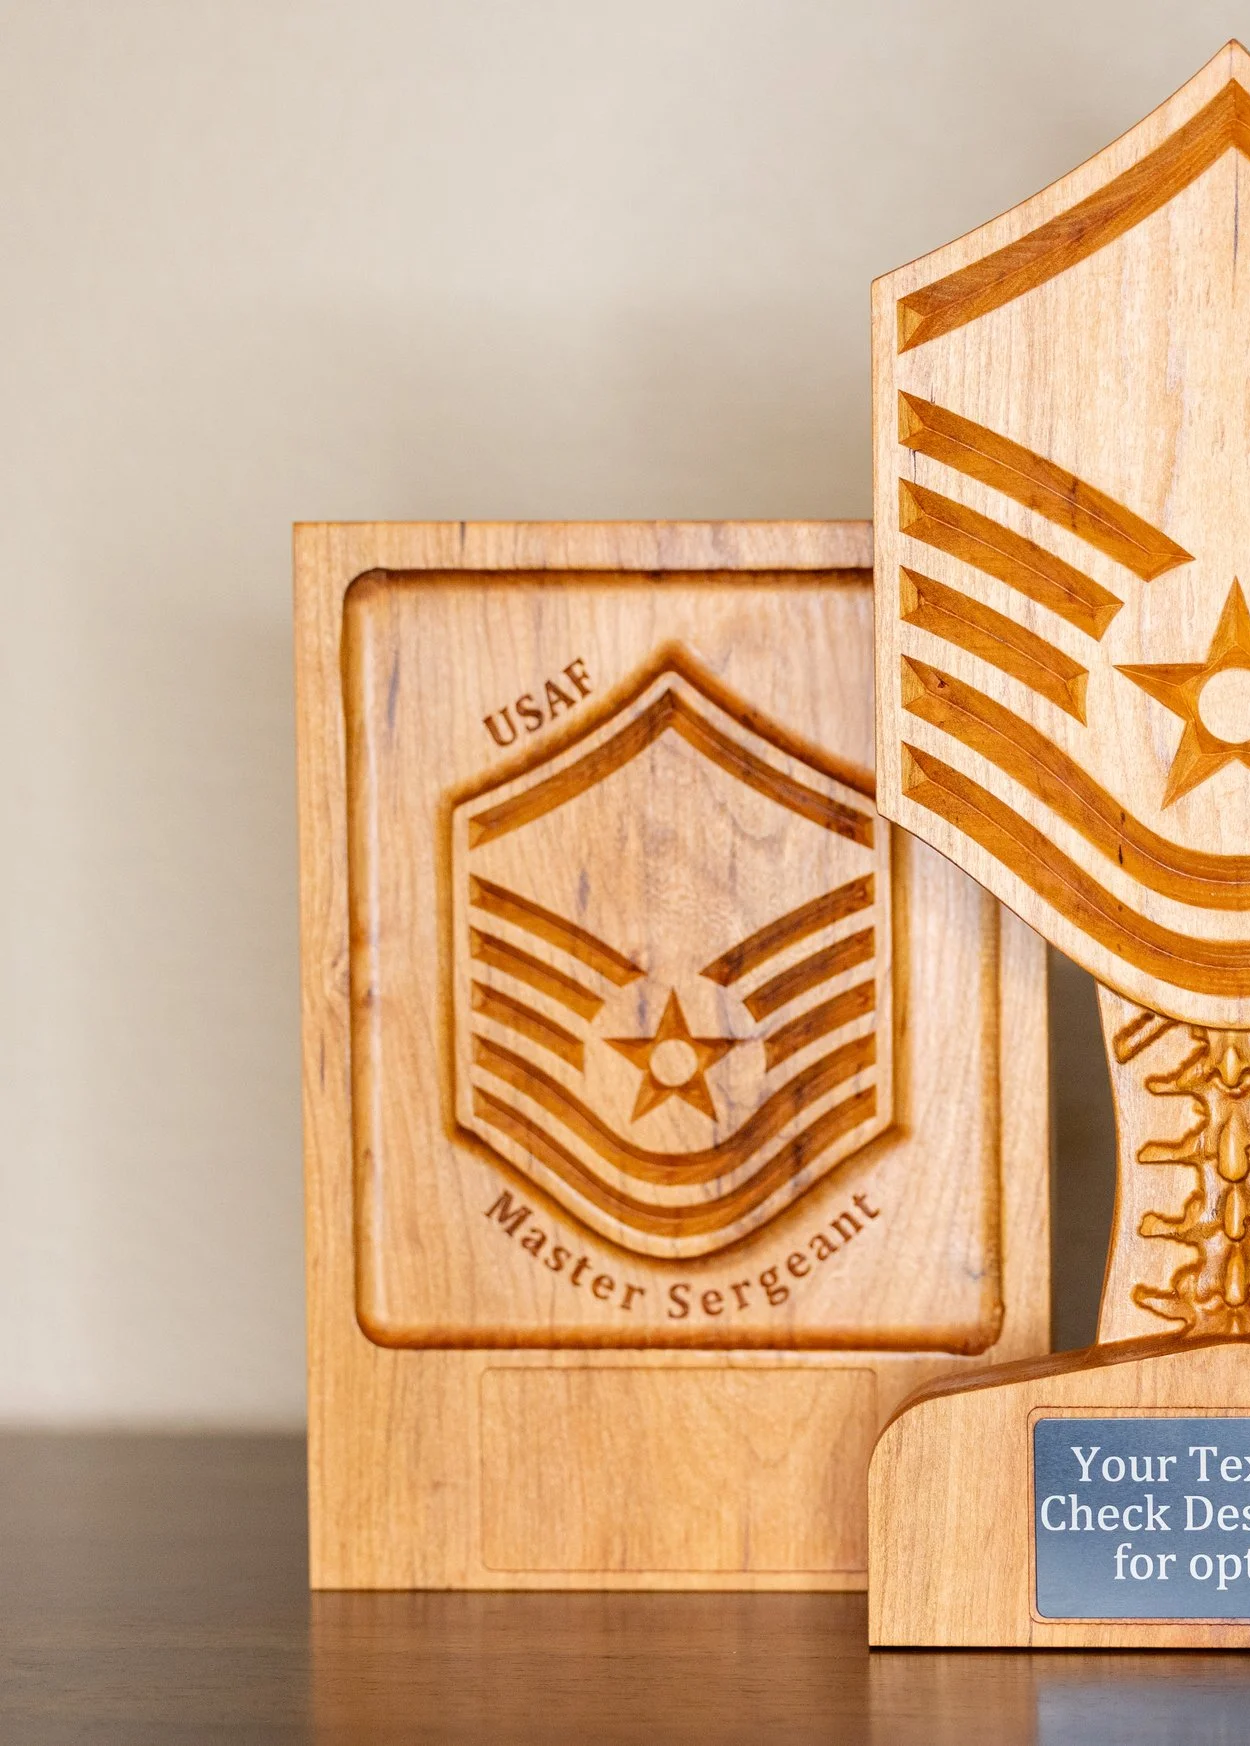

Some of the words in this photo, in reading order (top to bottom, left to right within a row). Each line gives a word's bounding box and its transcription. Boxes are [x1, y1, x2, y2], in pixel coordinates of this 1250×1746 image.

[482, 658, 592, 746] USAF
[484, 1190, 646, 1311] Master
[667, 1191, 881, 1320] Sergeant
[1071, 1446, 1177, 1482] Your
[1040, 1494, 1171, 1532] Check
[1113, 1543, 1176, 1580] for
